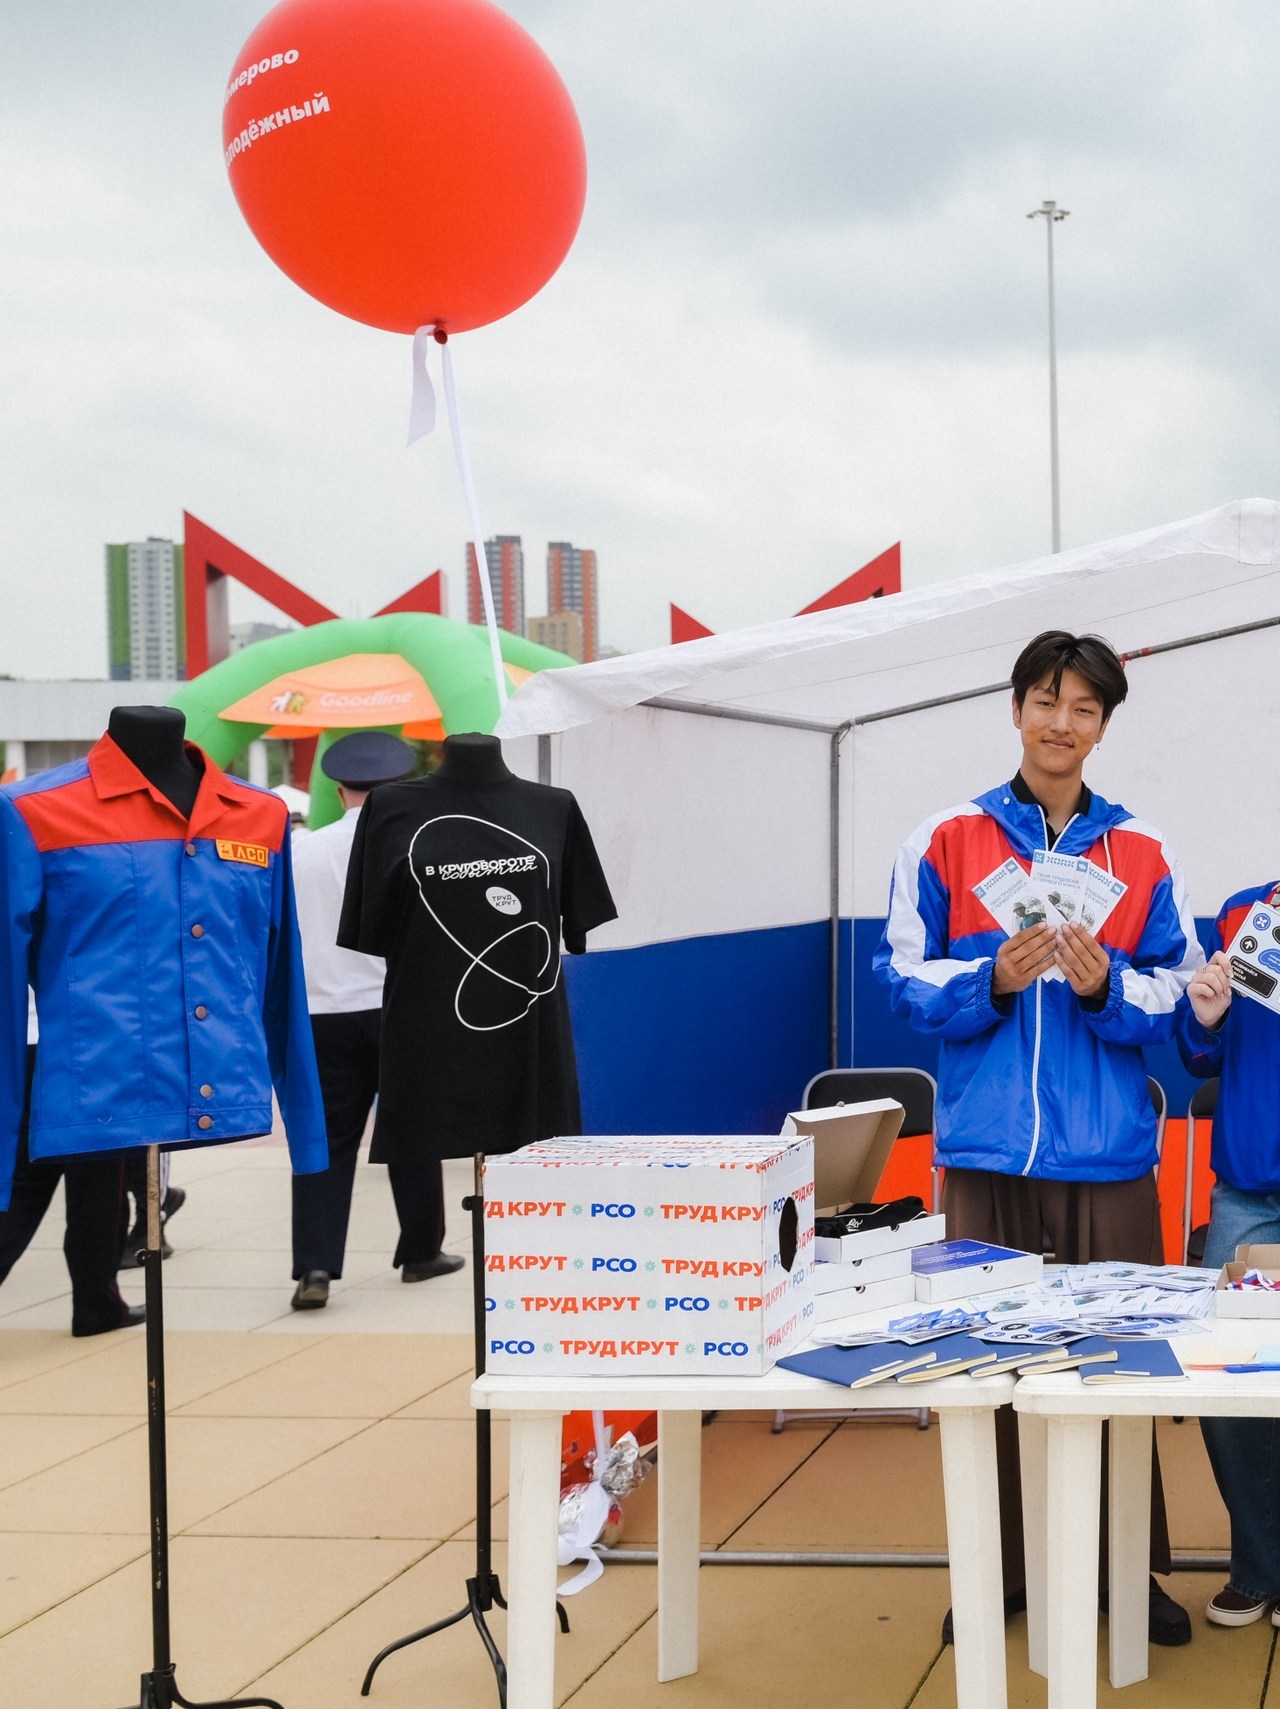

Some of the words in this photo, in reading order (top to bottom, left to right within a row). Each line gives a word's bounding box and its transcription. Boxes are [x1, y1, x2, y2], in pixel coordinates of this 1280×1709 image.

[319, 690, 413, 708] Goodline
[425, 865, 435, 876] В
[438, 857, 535, 875] КРУГОВОРОТЕ
[492, 894, 512, 902] ТРУД
[495, 899, 517, 908] КРУТ
[508, 1201, 566, 1217] КРУТ
[591, 1203, 636, 1218] РСО
[660, 1204, 718, 1223] ТРУД
[509, 1255, 568, 1271] КРУТ
[592, 1257, 637, 1273] РСО
[661, 1258, 719, 1278] ТРУД
[521, 1296, 579, 1314] ТРУД
[582, 1296, 640, 1312] КРУТ
[664, 1296, 710, 1312] РСО
[793, 1268, 805, 1288] РСО
[491, 1340, 535, 1355] РСО
[560, 1340, 618, 1358] ТРУД
[621, 1340, 679, 1356] КРУТ
[703, 1341, 749, 1357] РСО
[802, 1301, 814, 1320] РСО
